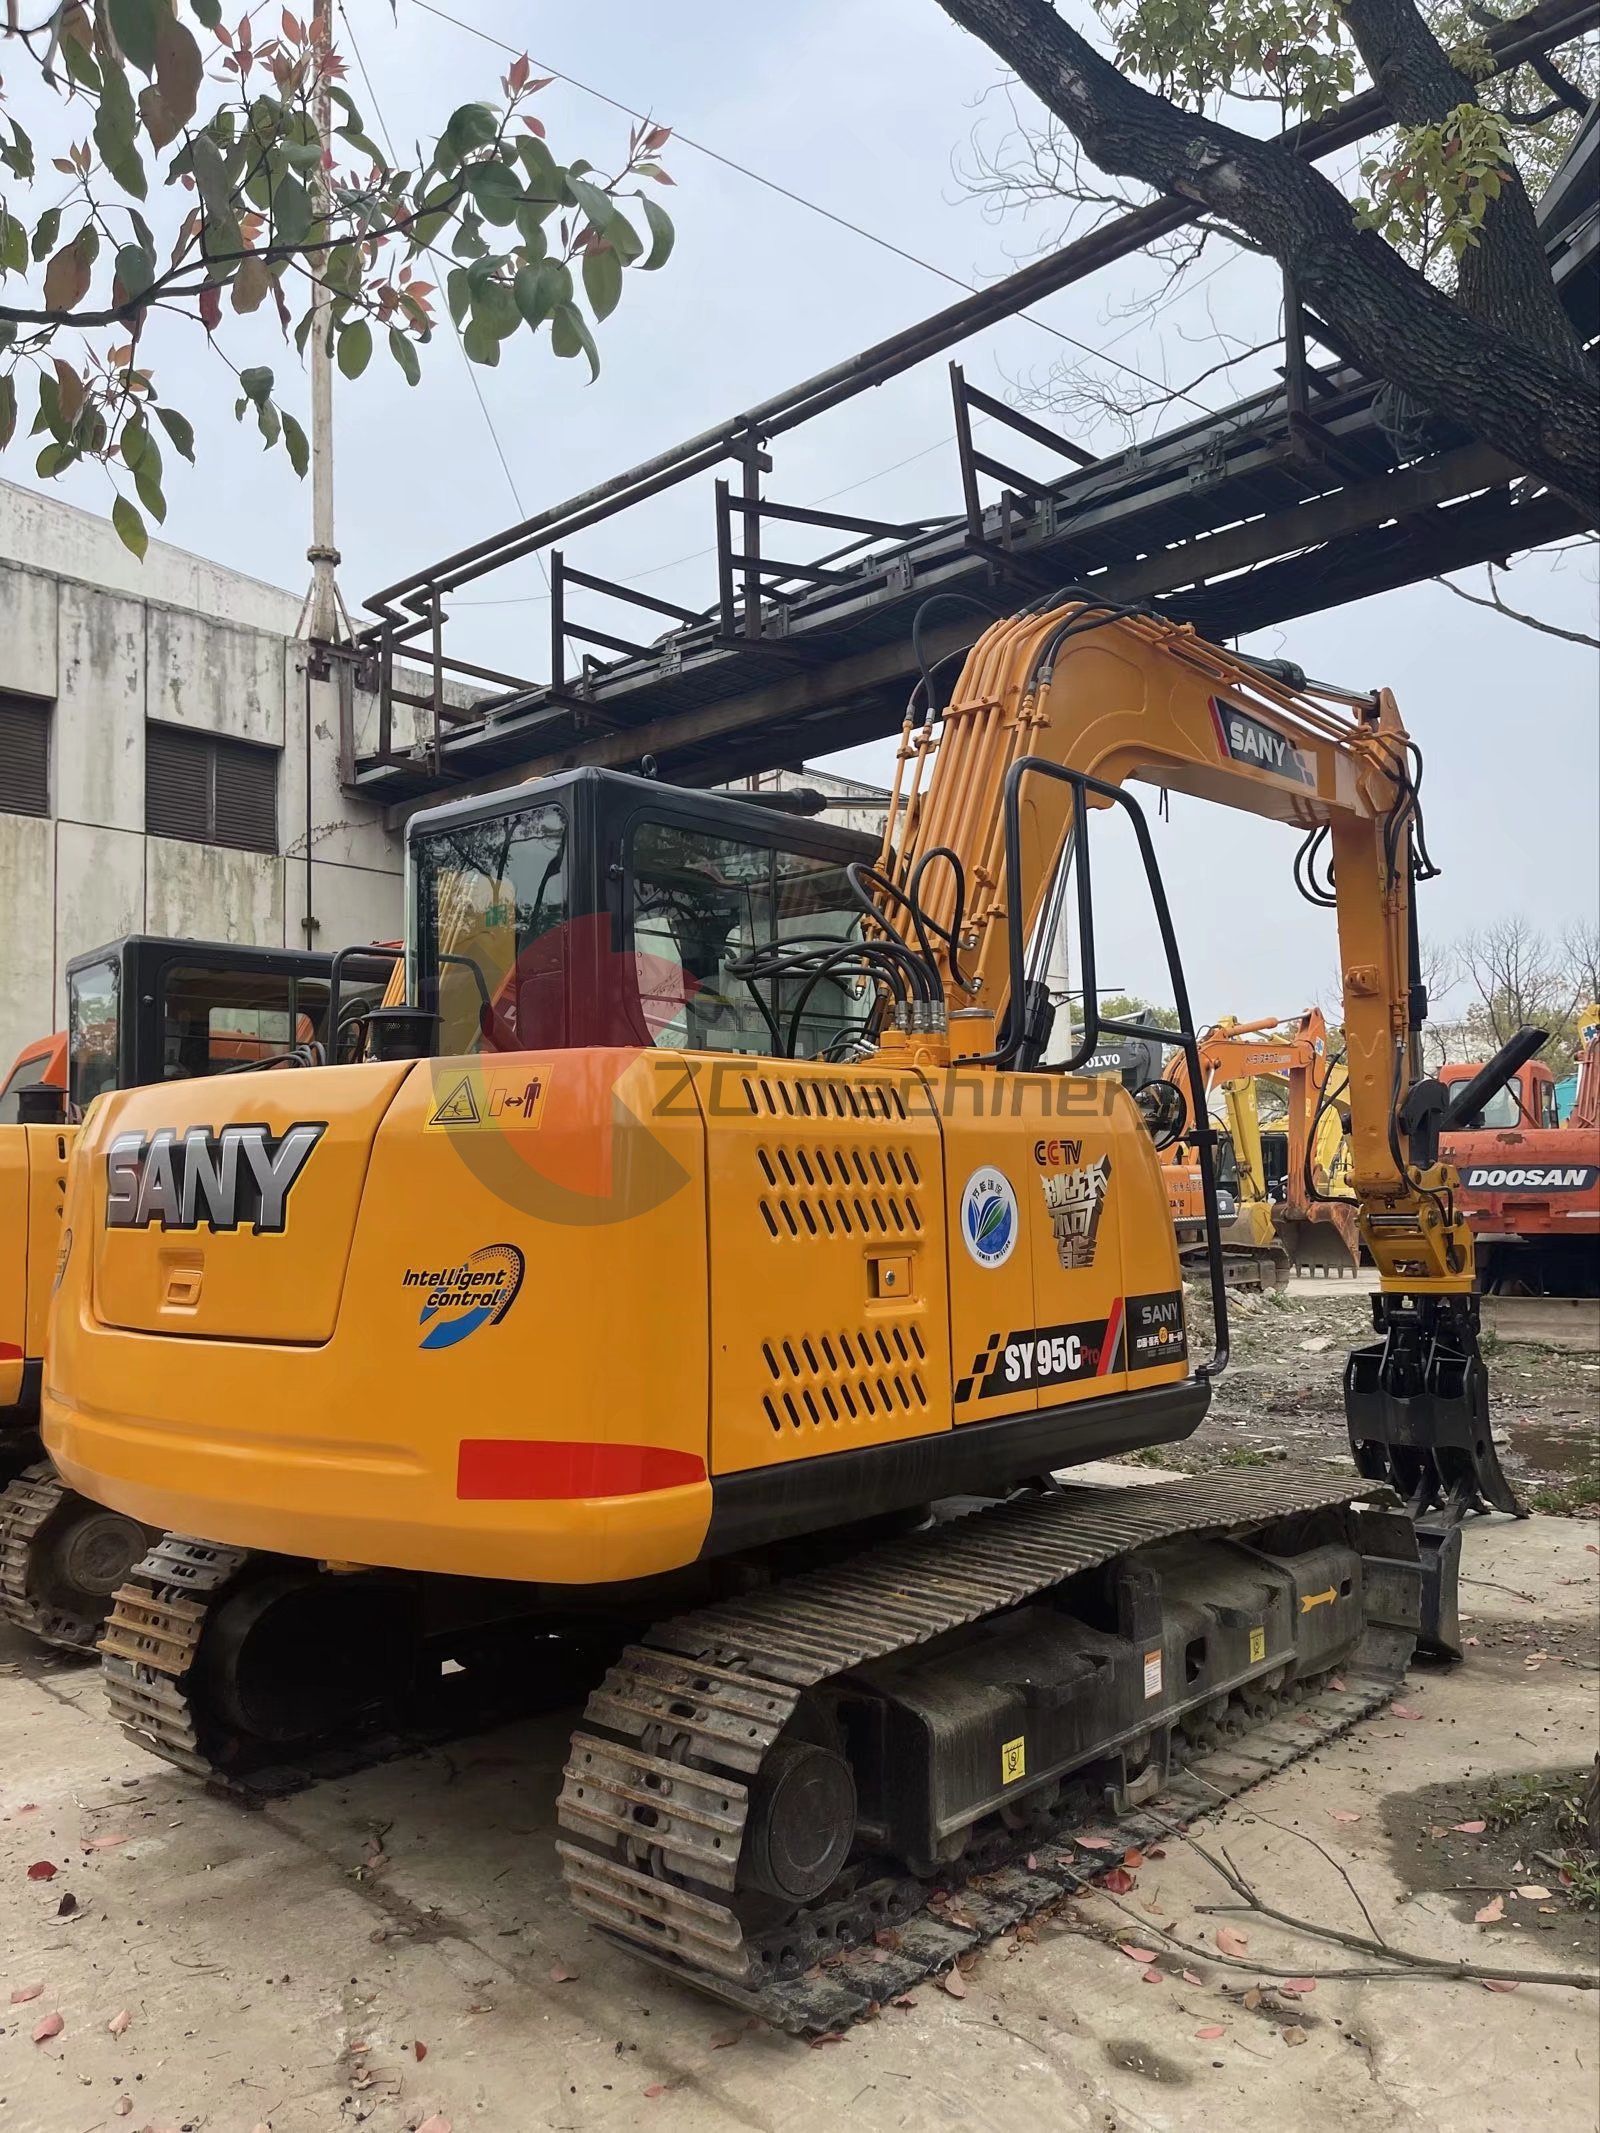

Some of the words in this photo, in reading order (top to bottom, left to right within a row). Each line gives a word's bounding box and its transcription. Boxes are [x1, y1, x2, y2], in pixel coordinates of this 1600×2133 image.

[1230, 721, 1286, 767] SANY
[1079, 1053, 1121, 1070] OLVO
[1034, 1139, 1083, 1166] CCTV
[106, 1124, 326, 1233] SANY
[1468, 1169, 1588, 1187] DOOSAN
[402, 1267, 508, 1291] Intelligent
[427, 1288, 501, 1307] control
[1142, 1302, 1178, 1325] SANY
[1004, 1335, 1082, 1382] SY95C
[1081, 1346, 1100, 1367] Pro
